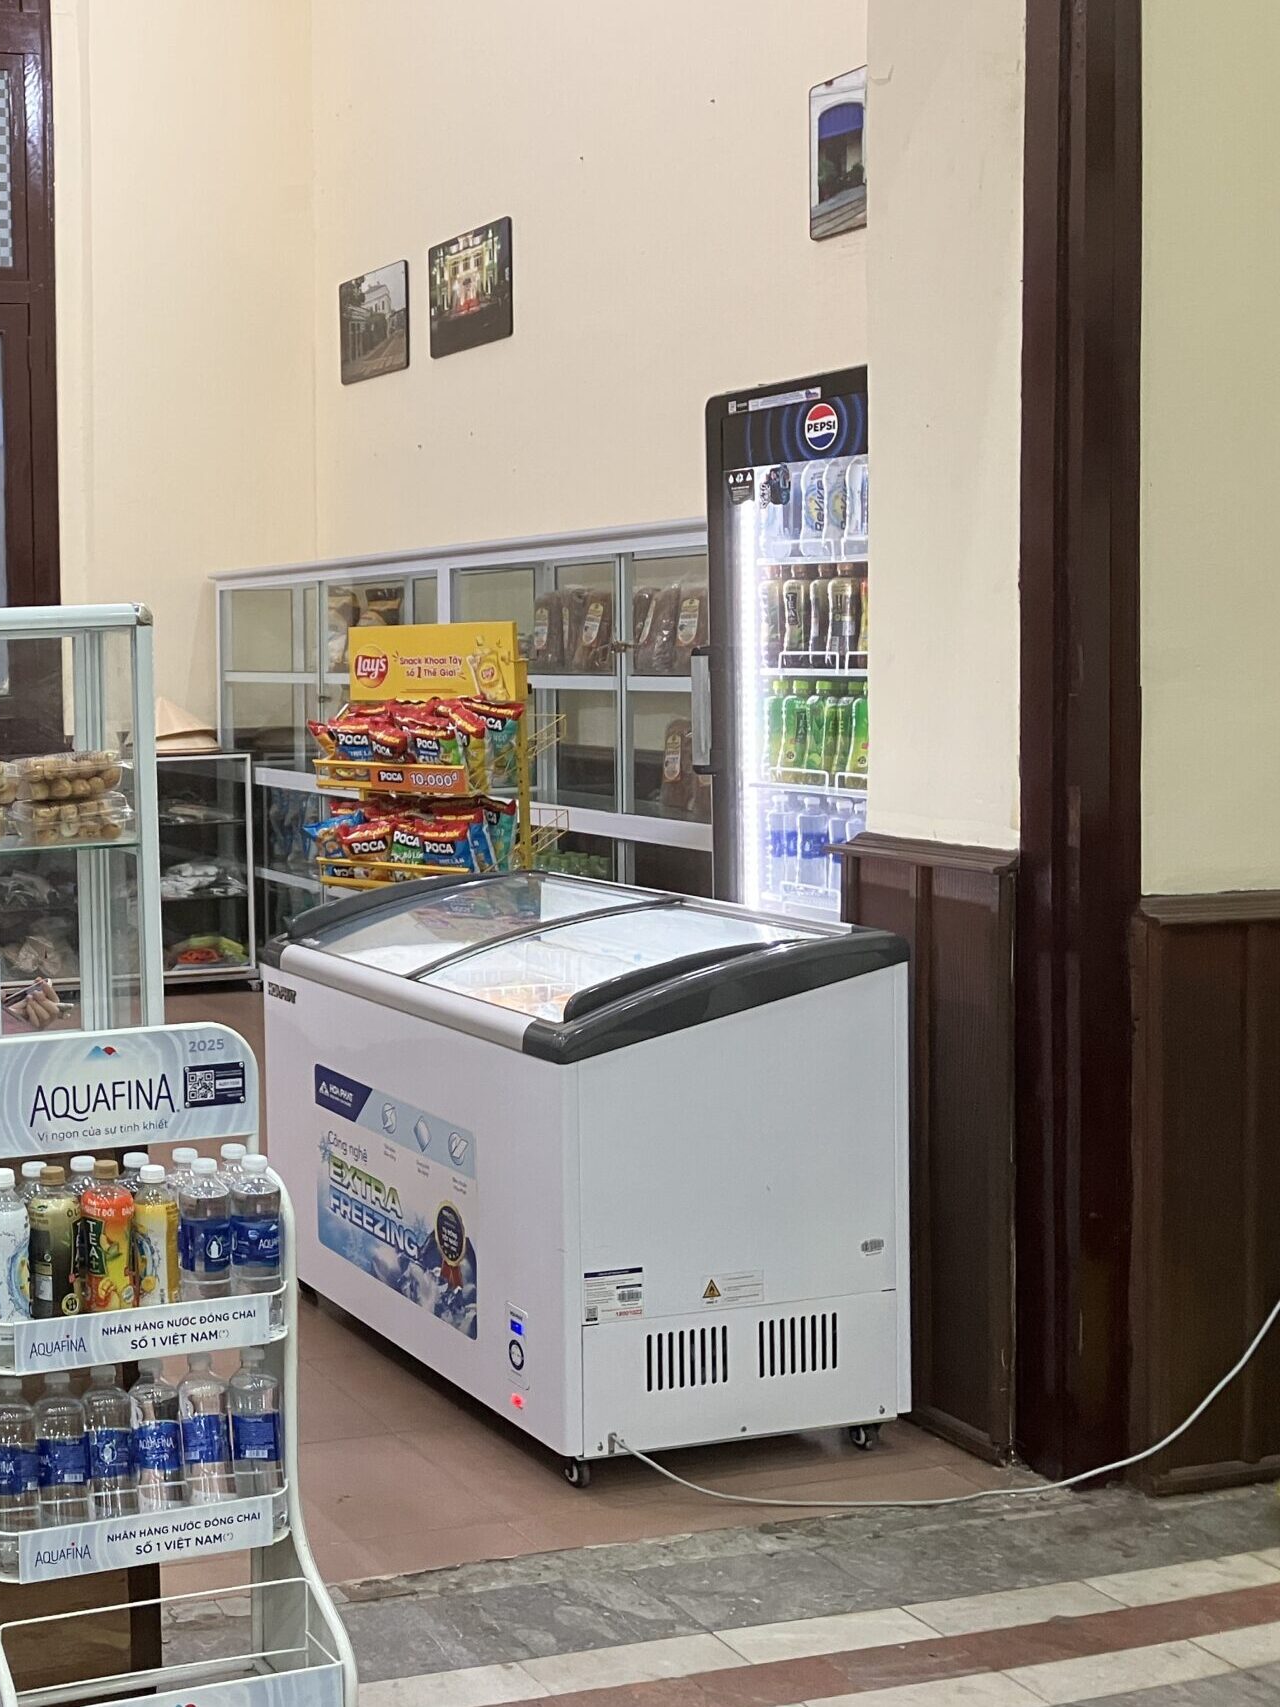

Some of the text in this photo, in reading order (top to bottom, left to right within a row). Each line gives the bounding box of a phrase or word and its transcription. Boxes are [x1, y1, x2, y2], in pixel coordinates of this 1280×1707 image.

[807, 420, 836, 433] PEPSI
[357, 655, 386, 679] Lay's
[399, 657, 422, 665] Snack
[425, 656, 446, 665] Khoai
[338, 734, 368, 745] POCA
[416, 738, 438, 750] POCA
[372, 741, 392, 756] POCA
[380, 771, 403, 781] POCA
[352, 840, 385, 853] POCA
[394, 831, 420, 847] POCA
[424, 841, 454, 854] POCA
[189, 1039, 224, 1052] 2025
[30, 1073, 176, 1127] AQUAFINA
[82, 1126, 101, 1137] của
[328, 1130, 348, 1156] Công
[329, 1154, 403, 1220] EXTRA
[329, 1184, 419, 1261] FREEZING
[134, 1319, 164, 1333] HÀNG
[232, 1309, 256, 1321] CHAI
[29, 1335, 87, 1359] AQUAFINA
[130, 1335, 148, 1350] SỐ
[151, 1337, 156, 1347] 1
[158, 1331, 187, 1346] VIỆT
[139, 1525, 169, 1539] HÀNG
[236, 1512, 261, 1524] CHAI
[34, 1542, 91, 1567] AQUAFINA
[135, 1540, 153, 1555] SỐ
[156, 1542, 161, 1552] 1
[164, 1537, 192, 1551] VIỆT
